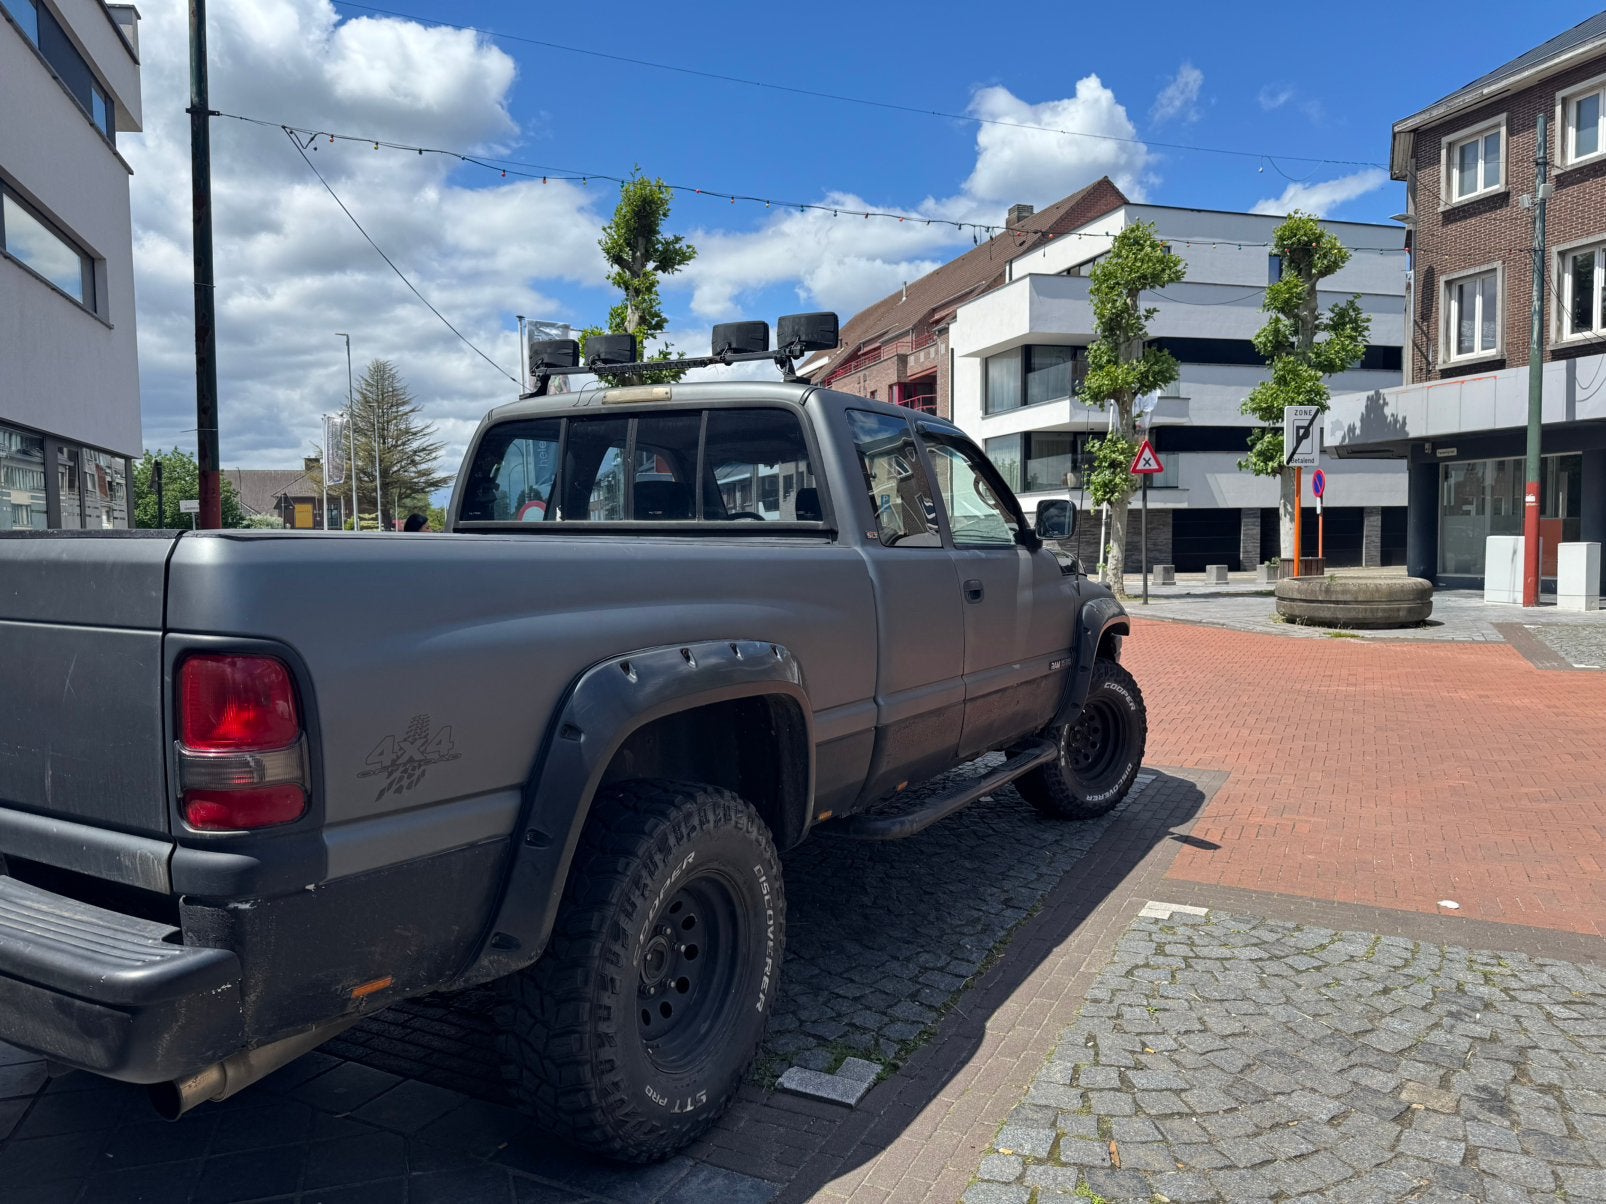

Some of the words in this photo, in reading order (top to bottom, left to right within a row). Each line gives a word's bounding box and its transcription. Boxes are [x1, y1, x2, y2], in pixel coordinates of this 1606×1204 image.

[1294, 409, 1313, 417] ZONE
[1295, 425, 1311, 445] P
[1103, 681, 1136, 711] COOPER
[1086, 762, 1133, 801] DISCOVERER
[633, 850, 696, 968] COOPER
[753, 863, 777, 1013] DISCOVERER
[645, 1084, 668, 1107] PRO
[670, 1088, 708, 1114] STT
